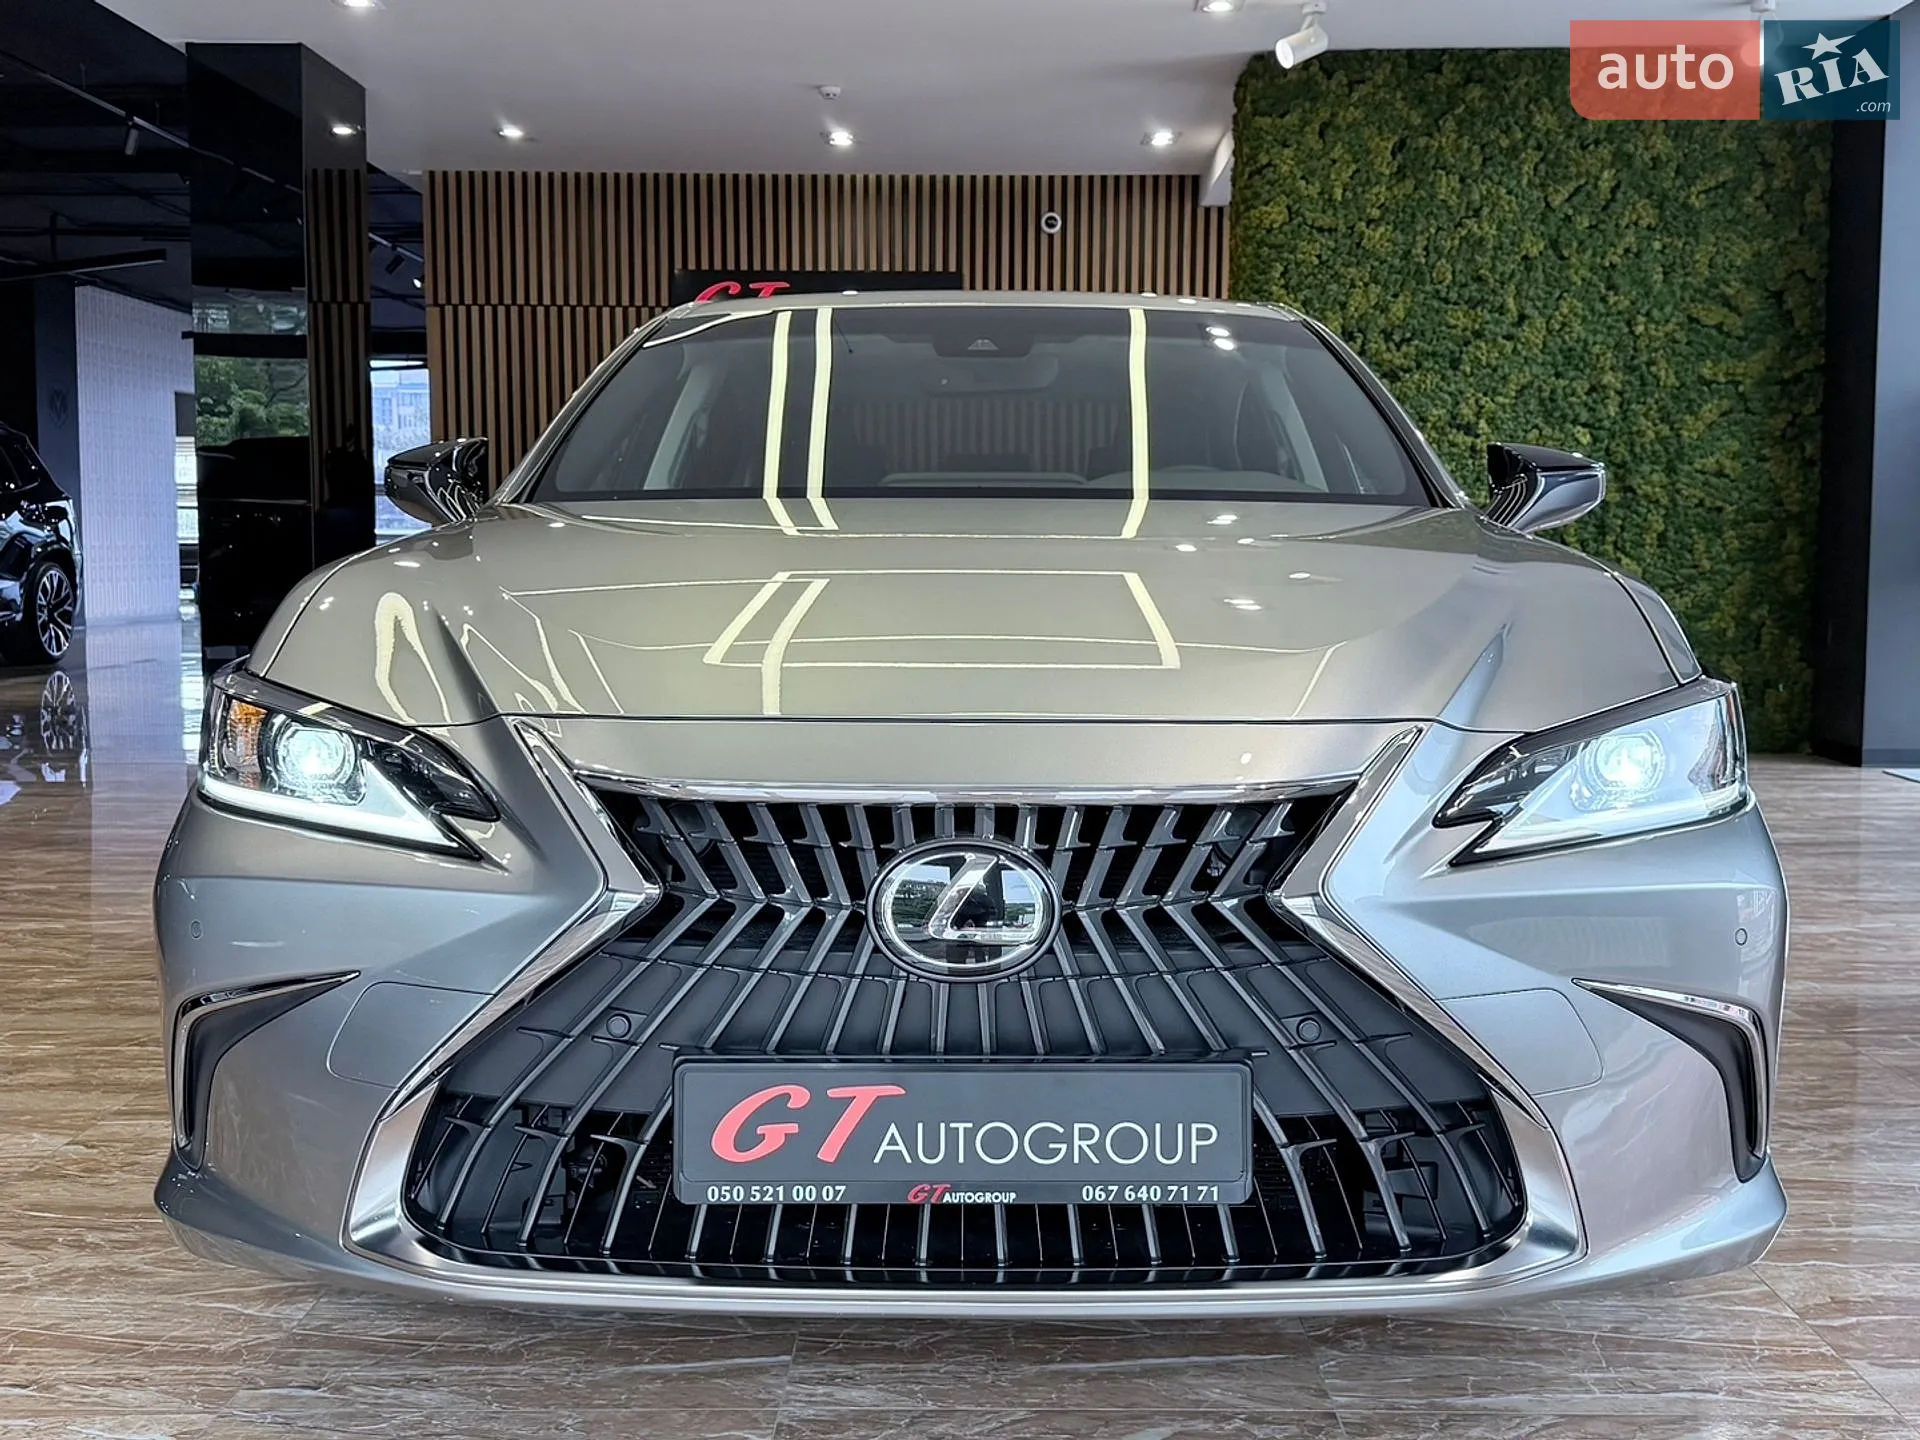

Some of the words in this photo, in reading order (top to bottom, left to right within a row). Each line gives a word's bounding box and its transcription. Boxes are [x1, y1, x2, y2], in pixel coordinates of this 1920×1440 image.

[711, 1084, 906, 1164] GT
[873, 1121, 1218, 1165] AUTOGROUP
[707, 1185, 745, 1202] 050
[750, 1185, 784, 1202] 521
[792, 1185, 817, 1202] 00
[822, 1185, 847, 1202] 07
[907, 1184, 950, 1204] GT
[942, 1191, 1017, 1204] AUTOGROUP
[1082, 1185, 1118, 1202] 067
[1125, 1185, 1162, 1202] 640
[1167, 1185, 1189, 1202] 71
[1197, 1185, 1219, 1202] 71
